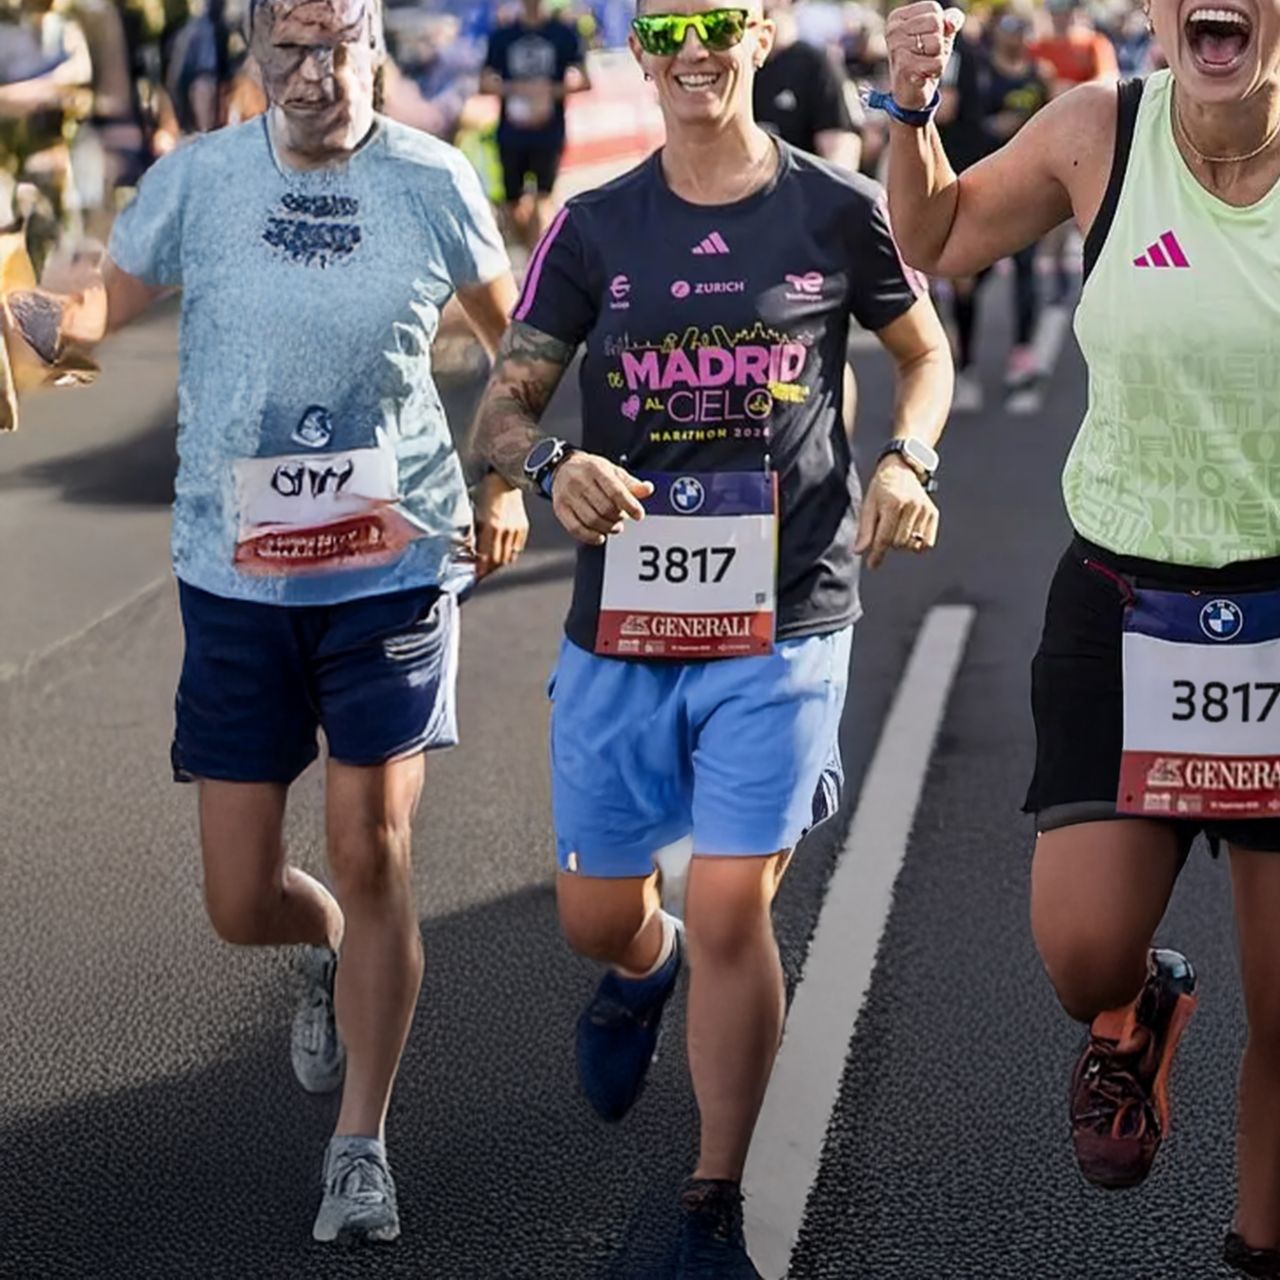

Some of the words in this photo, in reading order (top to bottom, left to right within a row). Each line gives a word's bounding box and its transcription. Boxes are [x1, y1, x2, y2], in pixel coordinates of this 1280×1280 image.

[695, 281, 744, 295] ZURICH
[621, 344, 806, 391] MADRID
[645, 397, 664, 411] AL
[668, 388, 773, 422] CIELO
[650, 428, 727, 442] MARATHON
[638, 545, 736, 584] 3817
[651, 616, 750, 638] GENERALI
